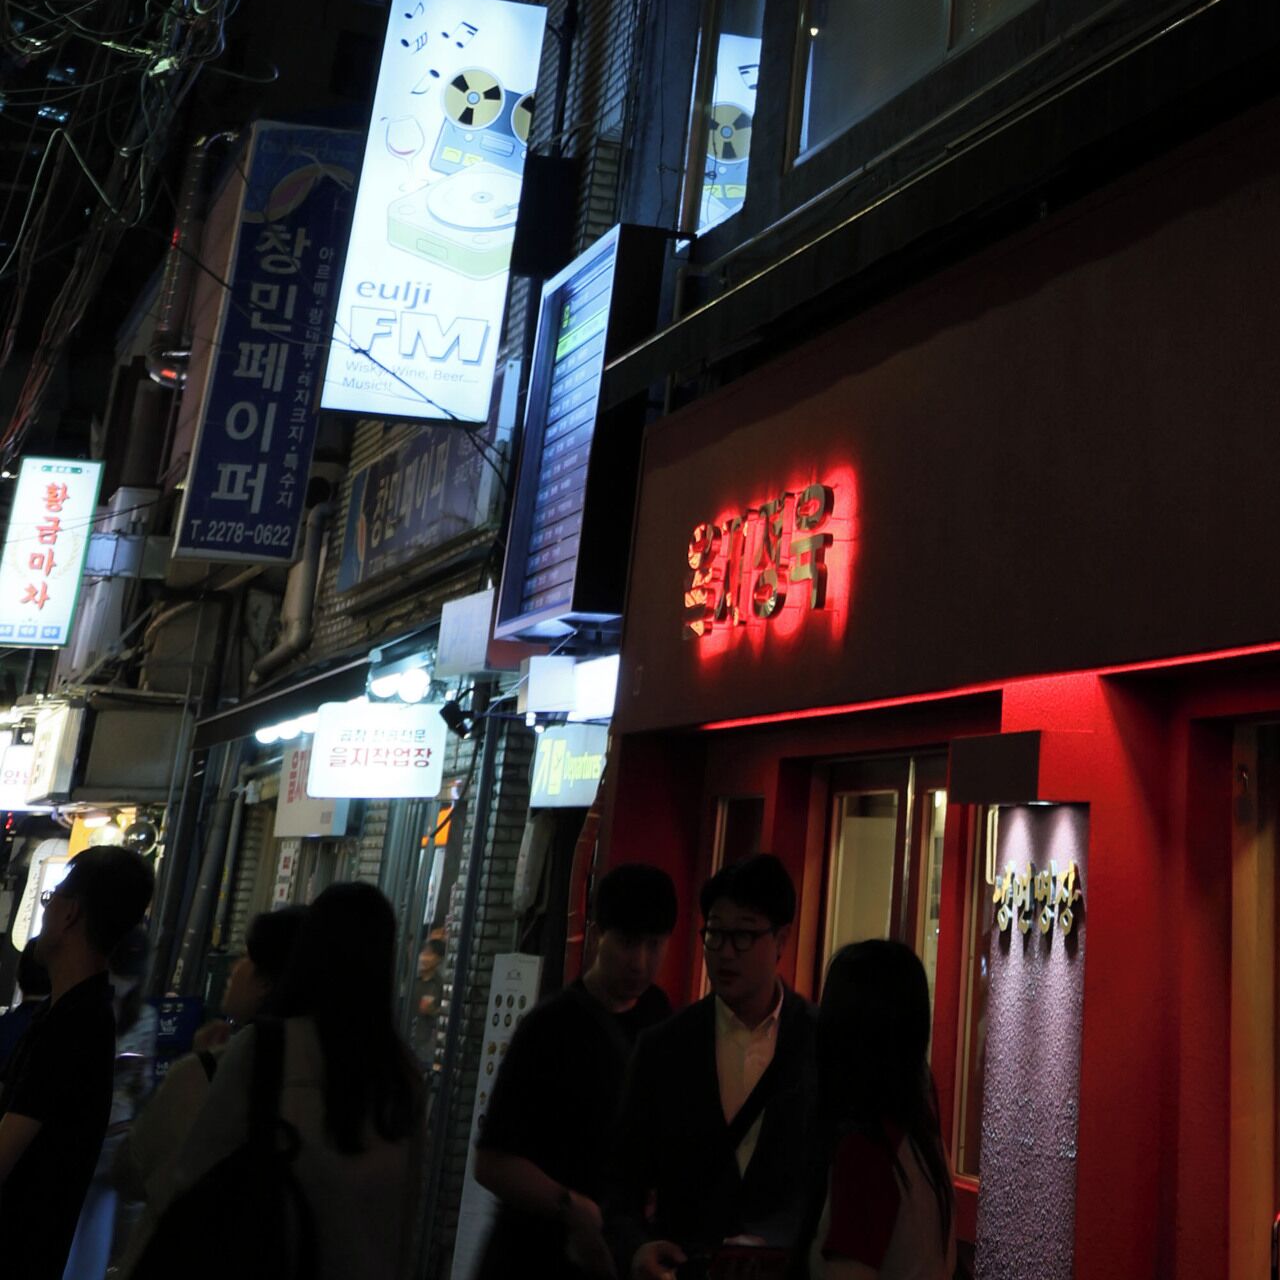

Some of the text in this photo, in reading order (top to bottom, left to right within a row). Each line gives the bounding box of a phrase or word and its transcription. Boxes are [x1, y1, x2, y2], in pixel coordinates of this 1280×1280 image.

[356, 280, 432, 310] eulji
[351, 305, 490, 367] FM
[210, 224, 311, 514] 창민페이퍼
[20, 481, 71, 611] 황금마차
[190, 519, 292, 547] T.2278-0622
[330, 747, 432, 768] 을지작업장
